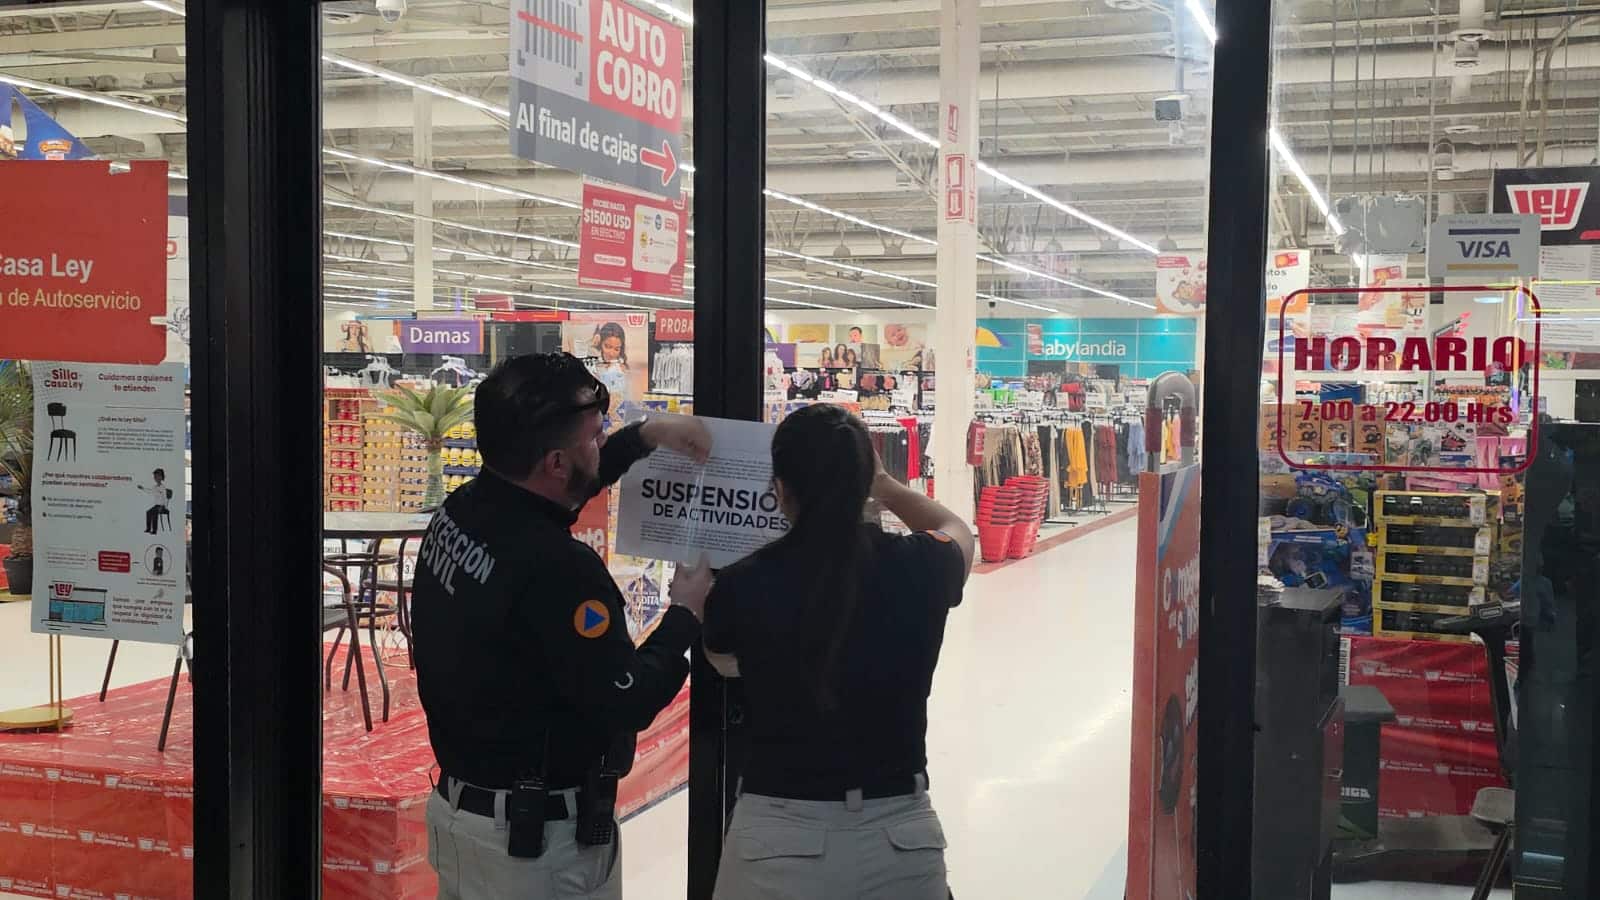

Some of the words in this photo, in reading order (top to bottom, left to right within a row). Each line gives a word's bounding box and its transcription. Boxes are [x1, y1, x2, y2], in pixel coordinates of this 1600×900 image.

[599, 1, 666, 67] AUTO
[597, 50, 677, 119] COBRO
[516, 102, 534, 133] Al
[538, 107, 576, 145] final
[579, 121, 600, 152] de
[602, 133, 638, 165] cajas
[583, 208, 612, 226] $1500
[613, 214, 632, 230] USD
[1456, 240, 1511, 258] VISA
[51, 253, 93, 283] Ley
[8, 288, 29, 306] de
[33, 288, 141, 310] Autoservicio
[409, 327, 470, 345] Damas
[1042, 339, 1126, 359] abylandia
[1294, 336, 1527, 371] HORARIO
[52, 368, 78, 380] Silla
[98, 373, 135, 382] Cuidamos
[143, 375, 173, 383] quienes
[1301, 401, 1354, 422] 7:00
[1361, 405, 1376, 422] a
[1466, 402, 1513, 423] Hrs
[653, 503, 673, 519] DE
[677, 507, 789, 530] ACTIVIDADES
[422, 532, 457, 595] CIVIL
